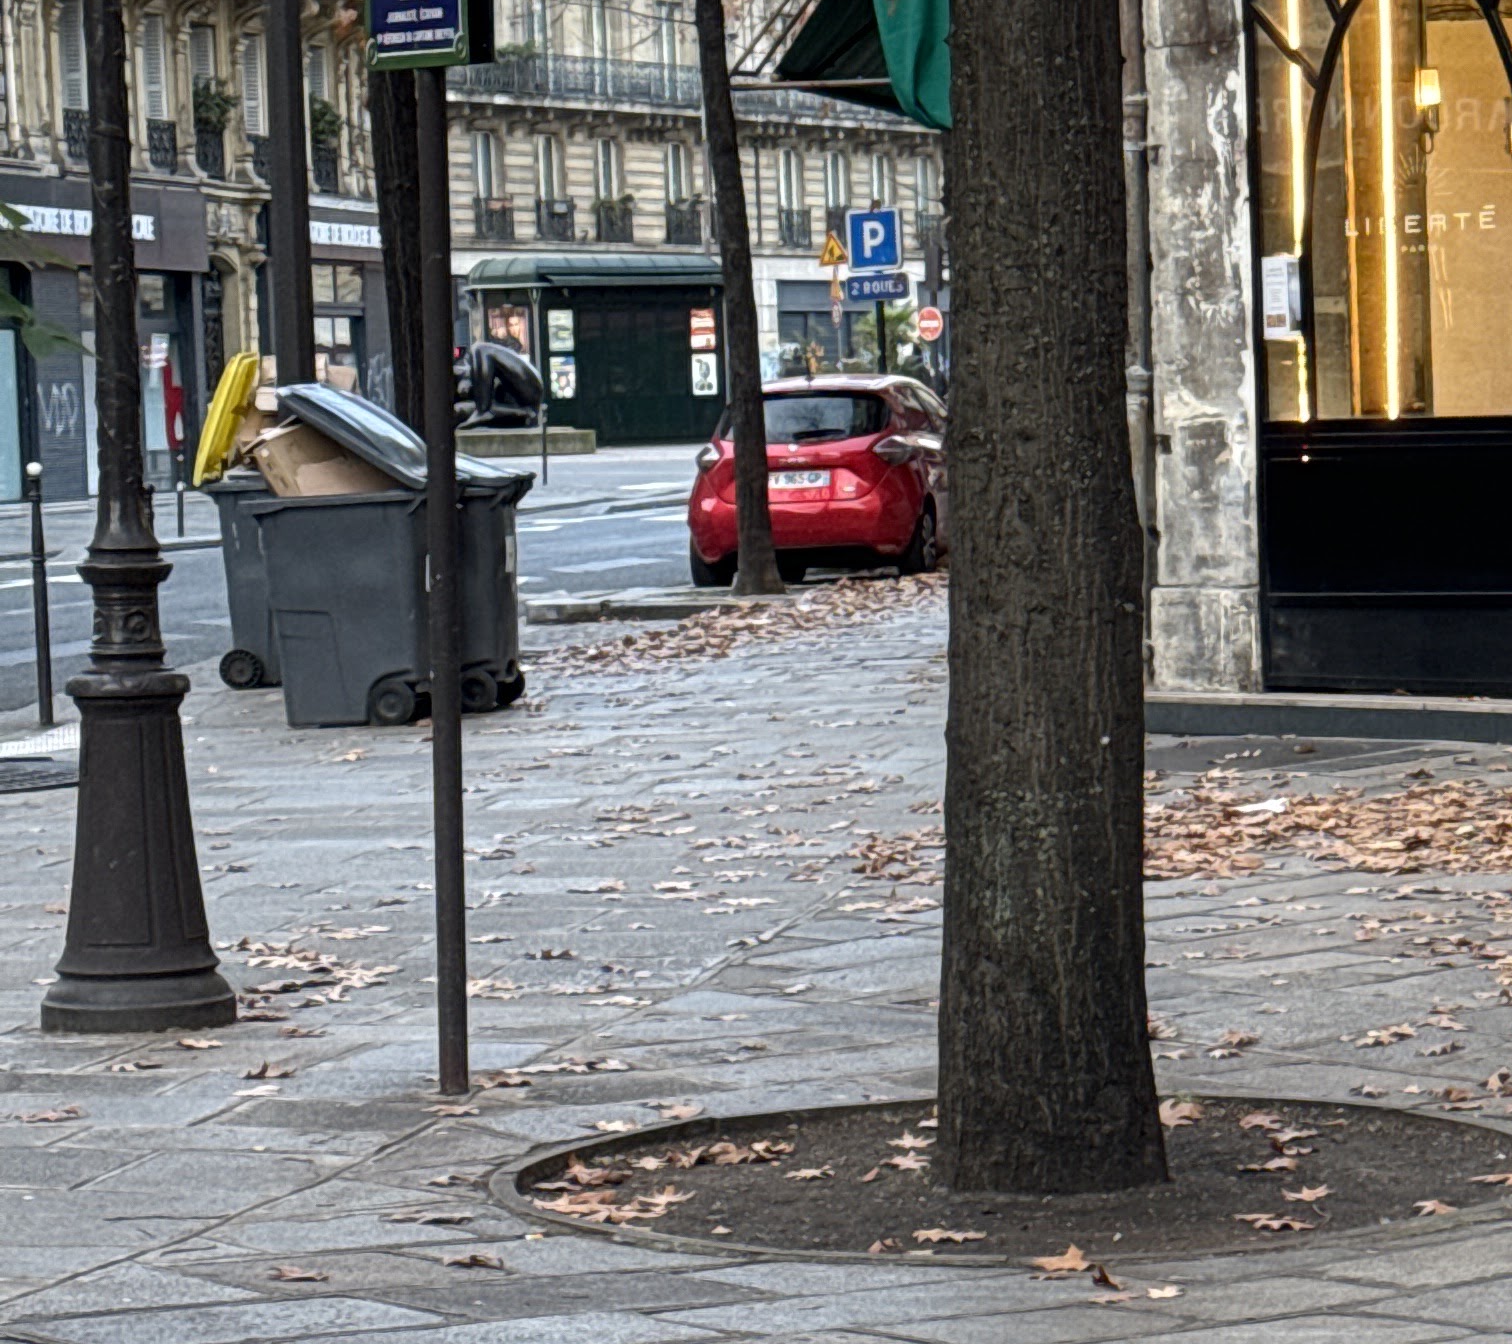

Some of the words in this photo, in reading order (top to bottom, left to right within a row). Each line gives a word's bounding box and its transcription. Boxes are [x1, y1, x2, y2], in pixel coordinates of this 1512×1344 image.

[863, 220, 885, 258] P
[851, 282, 860, 296] 2
[863, 280, 904, 295] ROUES
